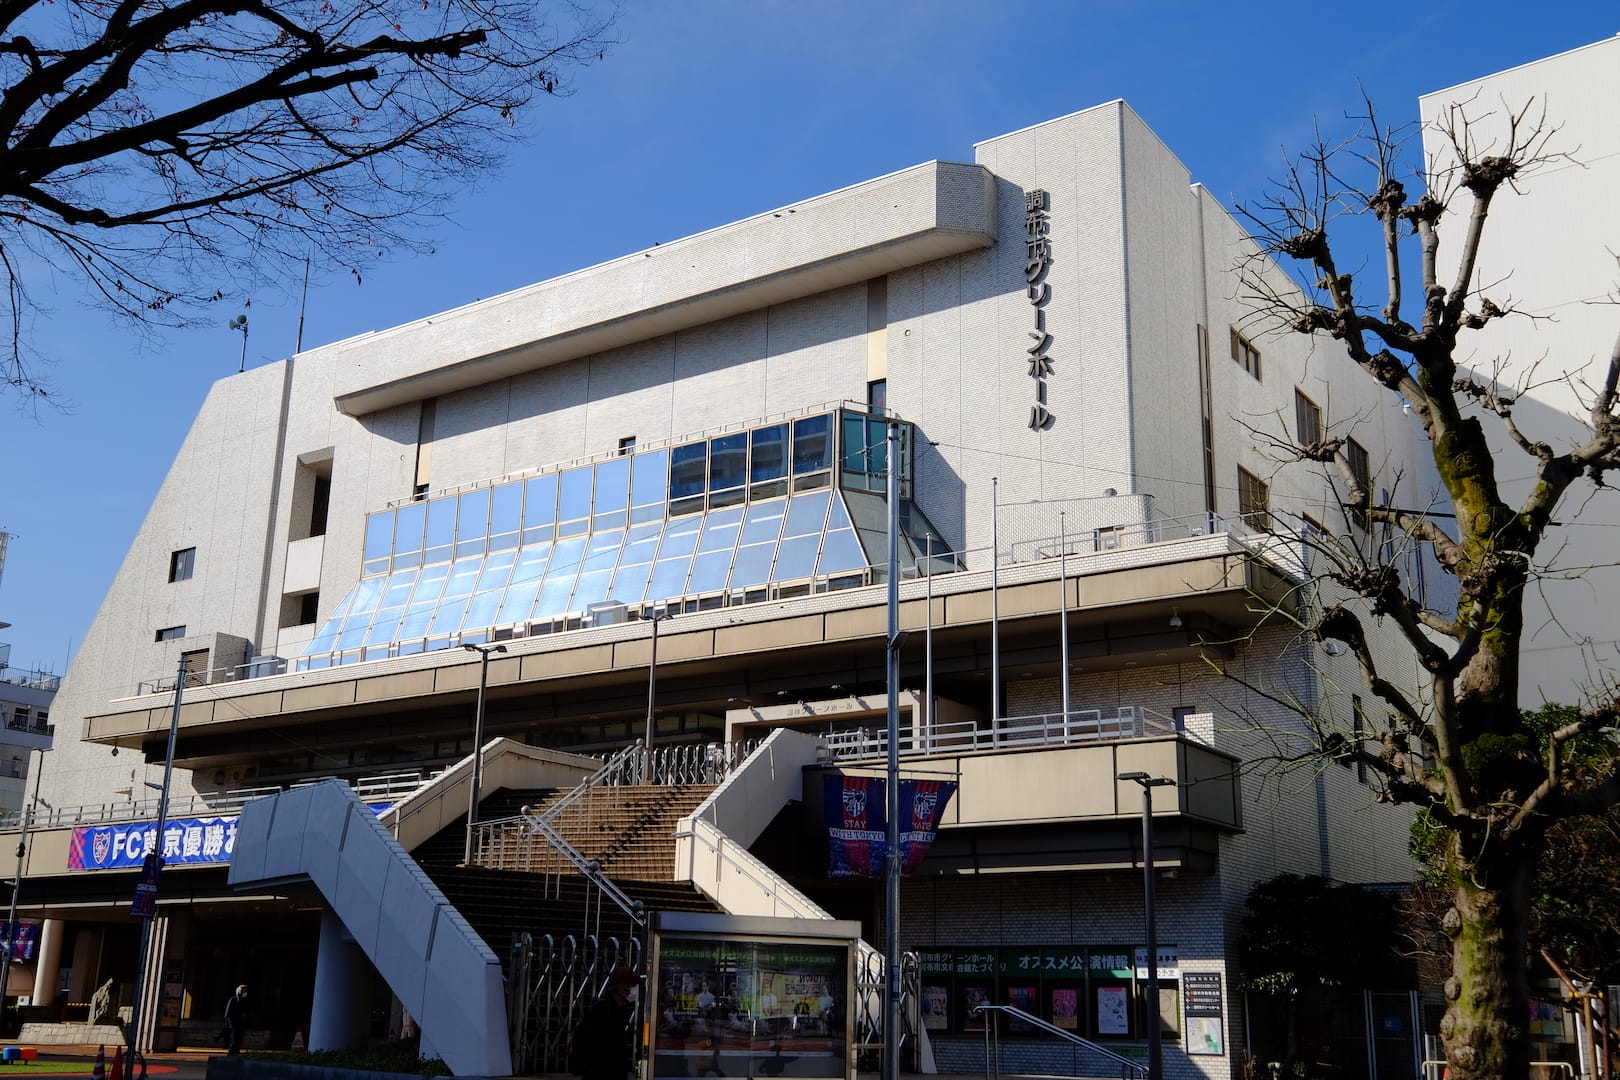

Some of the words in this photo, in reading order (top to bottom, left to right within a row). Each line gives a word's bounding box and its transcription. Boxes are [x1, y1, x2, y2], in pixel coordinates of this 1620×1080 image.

[1024, 188, 1049, 431] 調布市グリーンホール
[844, 819, 866, 829] STAY
[832, 829, 853, 839] WITH
[854, 831, 884, 840] TOKYO
[1018, 954, 1128, 970] オススメ公演情報
